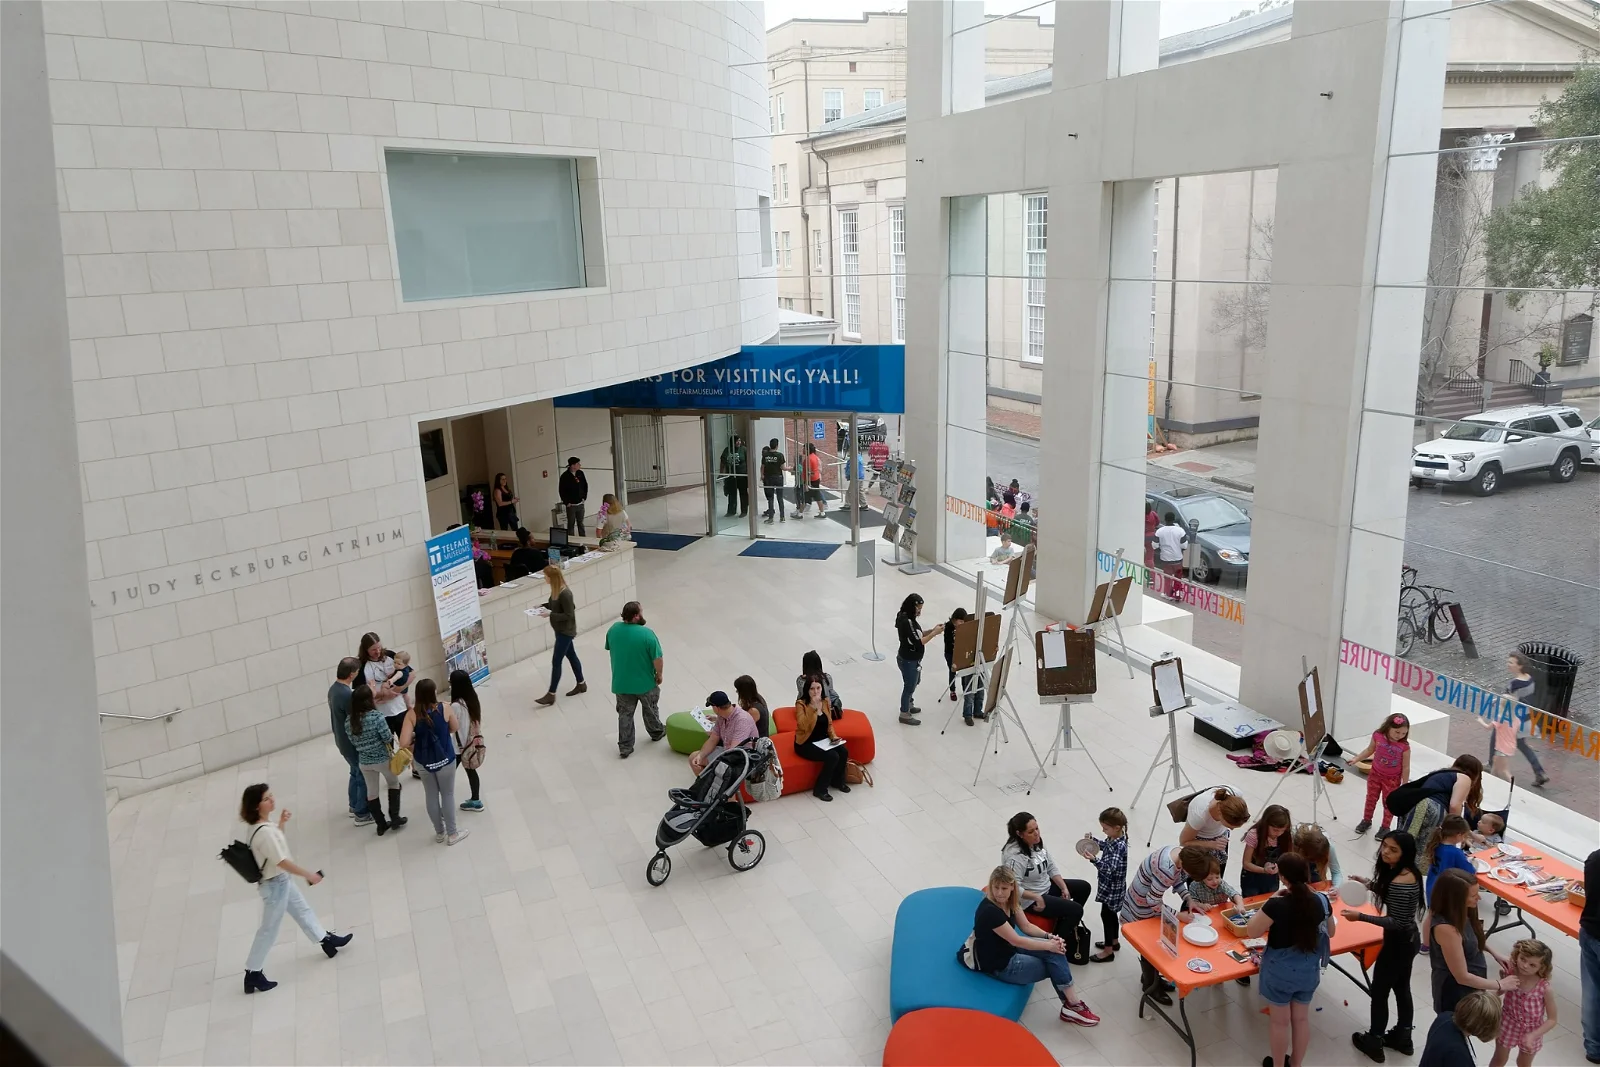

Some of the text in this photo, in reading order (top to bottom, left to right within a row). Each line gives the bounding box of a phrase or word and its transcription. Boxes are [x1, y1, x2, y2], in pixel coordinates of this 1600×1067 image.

[672, 368, 706, 383] FOR
[714, 368, 801, 385] VISITING,
[804, 369, 859, 384] Y'ALL!
[729, 388, 782, 396] #JEPSONCENTER
[441, 537, 469, 553] TELFAIR
[444, 545, 470, 560] MUSEUMS
[111, 528, 403, 605] JUDY ECKBURG ATRIUM
[433, 571, 453, 587] JOIN!
